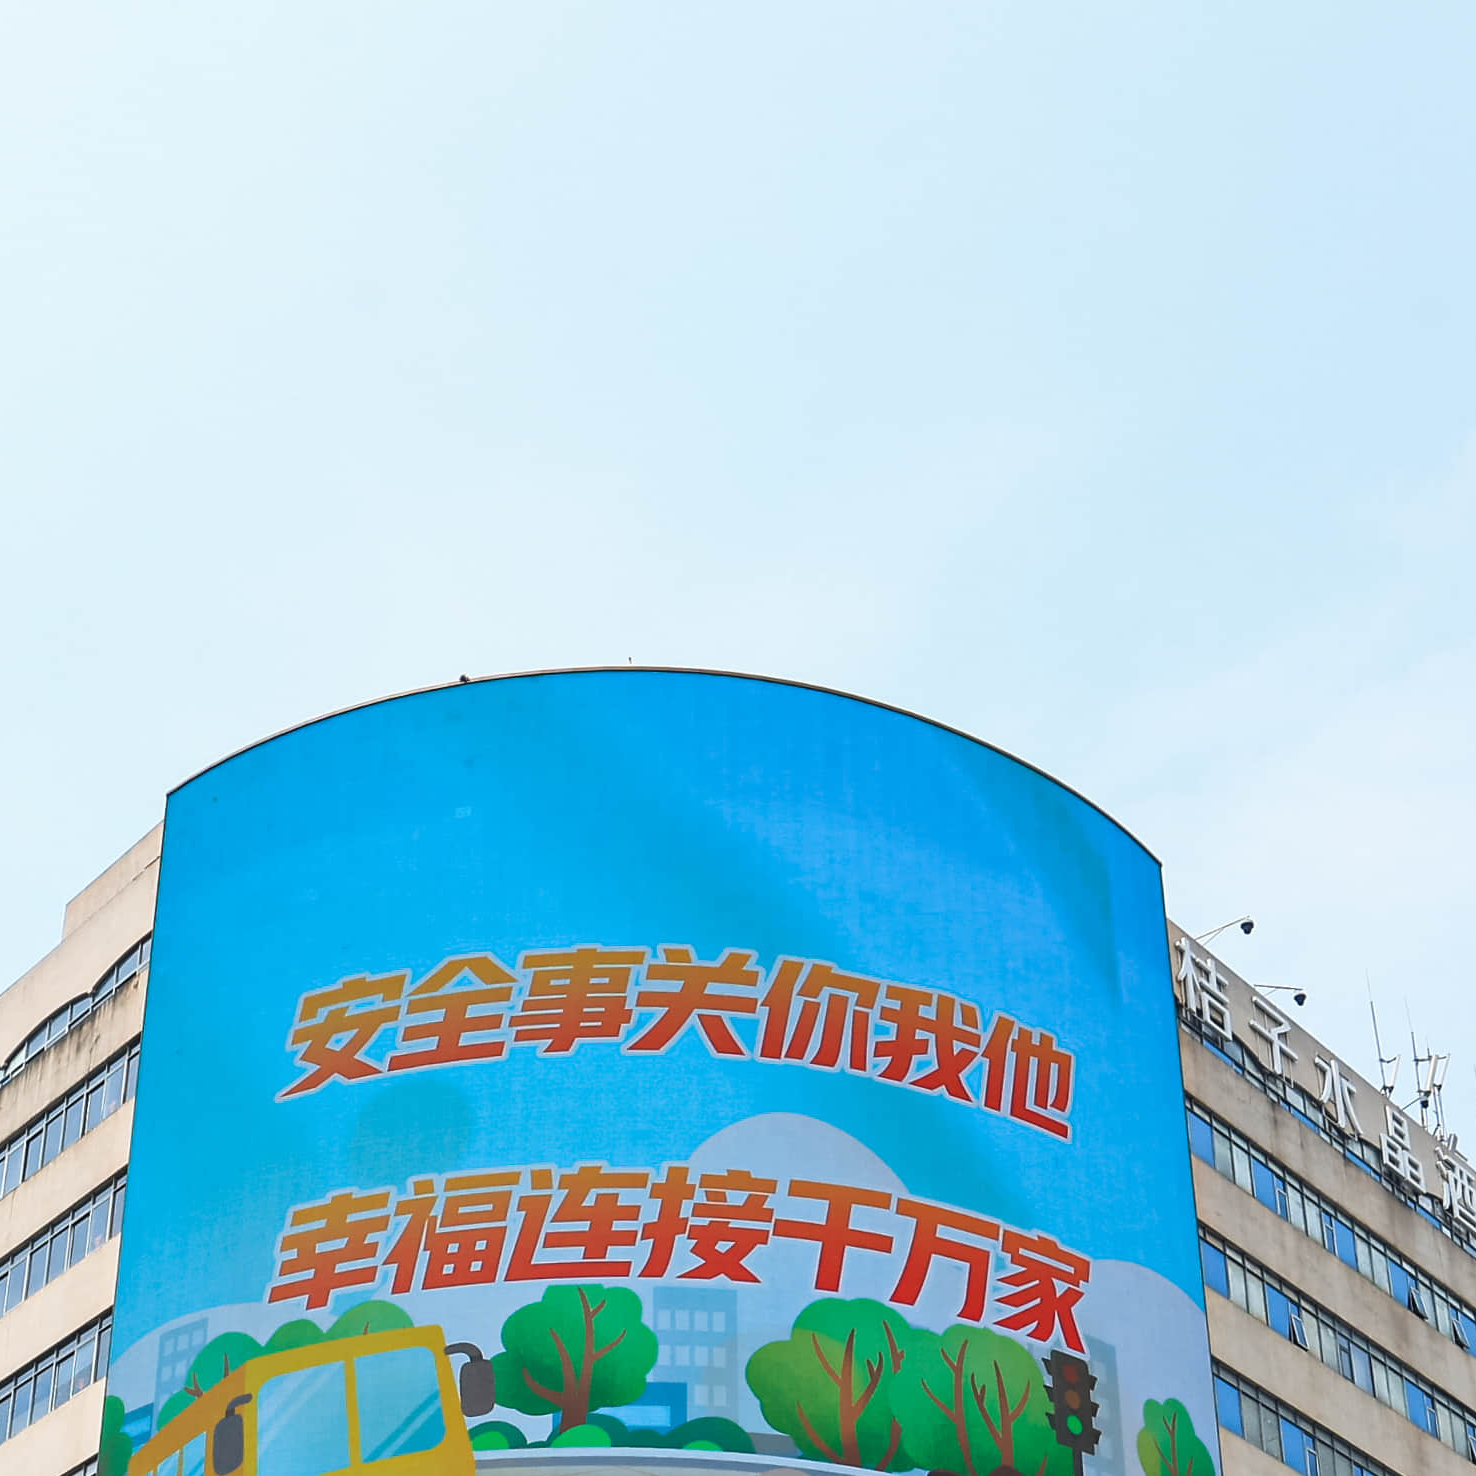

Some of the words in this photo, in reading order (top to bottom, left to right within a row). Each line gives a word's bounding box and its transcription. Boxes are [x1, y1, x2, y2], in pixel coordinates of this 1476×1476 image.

[275, 944, 1075, 1143] 安全事关你我他
[267, 1163, 1092, 1354] 幸福连接千万家
